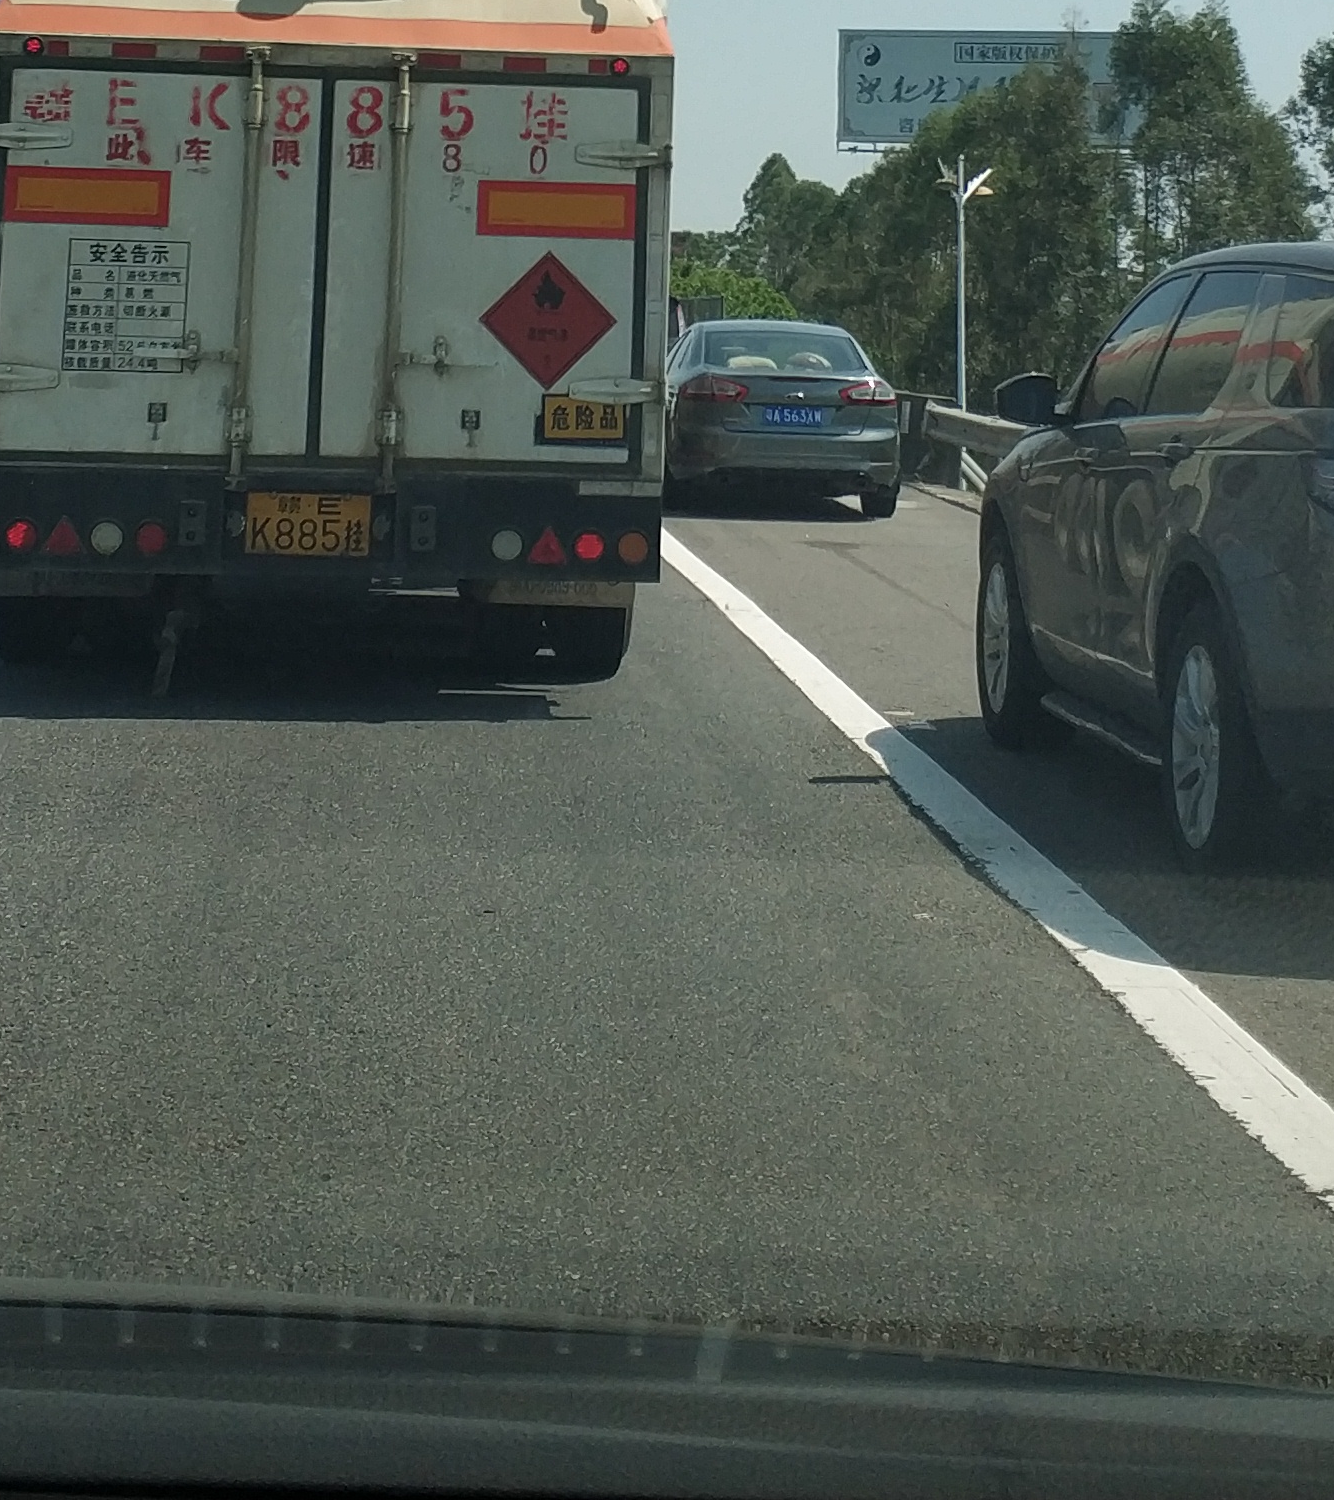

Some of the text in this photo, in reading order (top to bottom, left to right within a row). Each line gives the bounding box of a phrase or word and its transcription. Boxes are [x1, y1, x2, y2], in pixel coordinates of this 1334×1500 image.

[89, 242, 170, 265] 安全告示
[67, 321, 114, 334] 联系电话
[550, 404, 618, 431] 危险品
